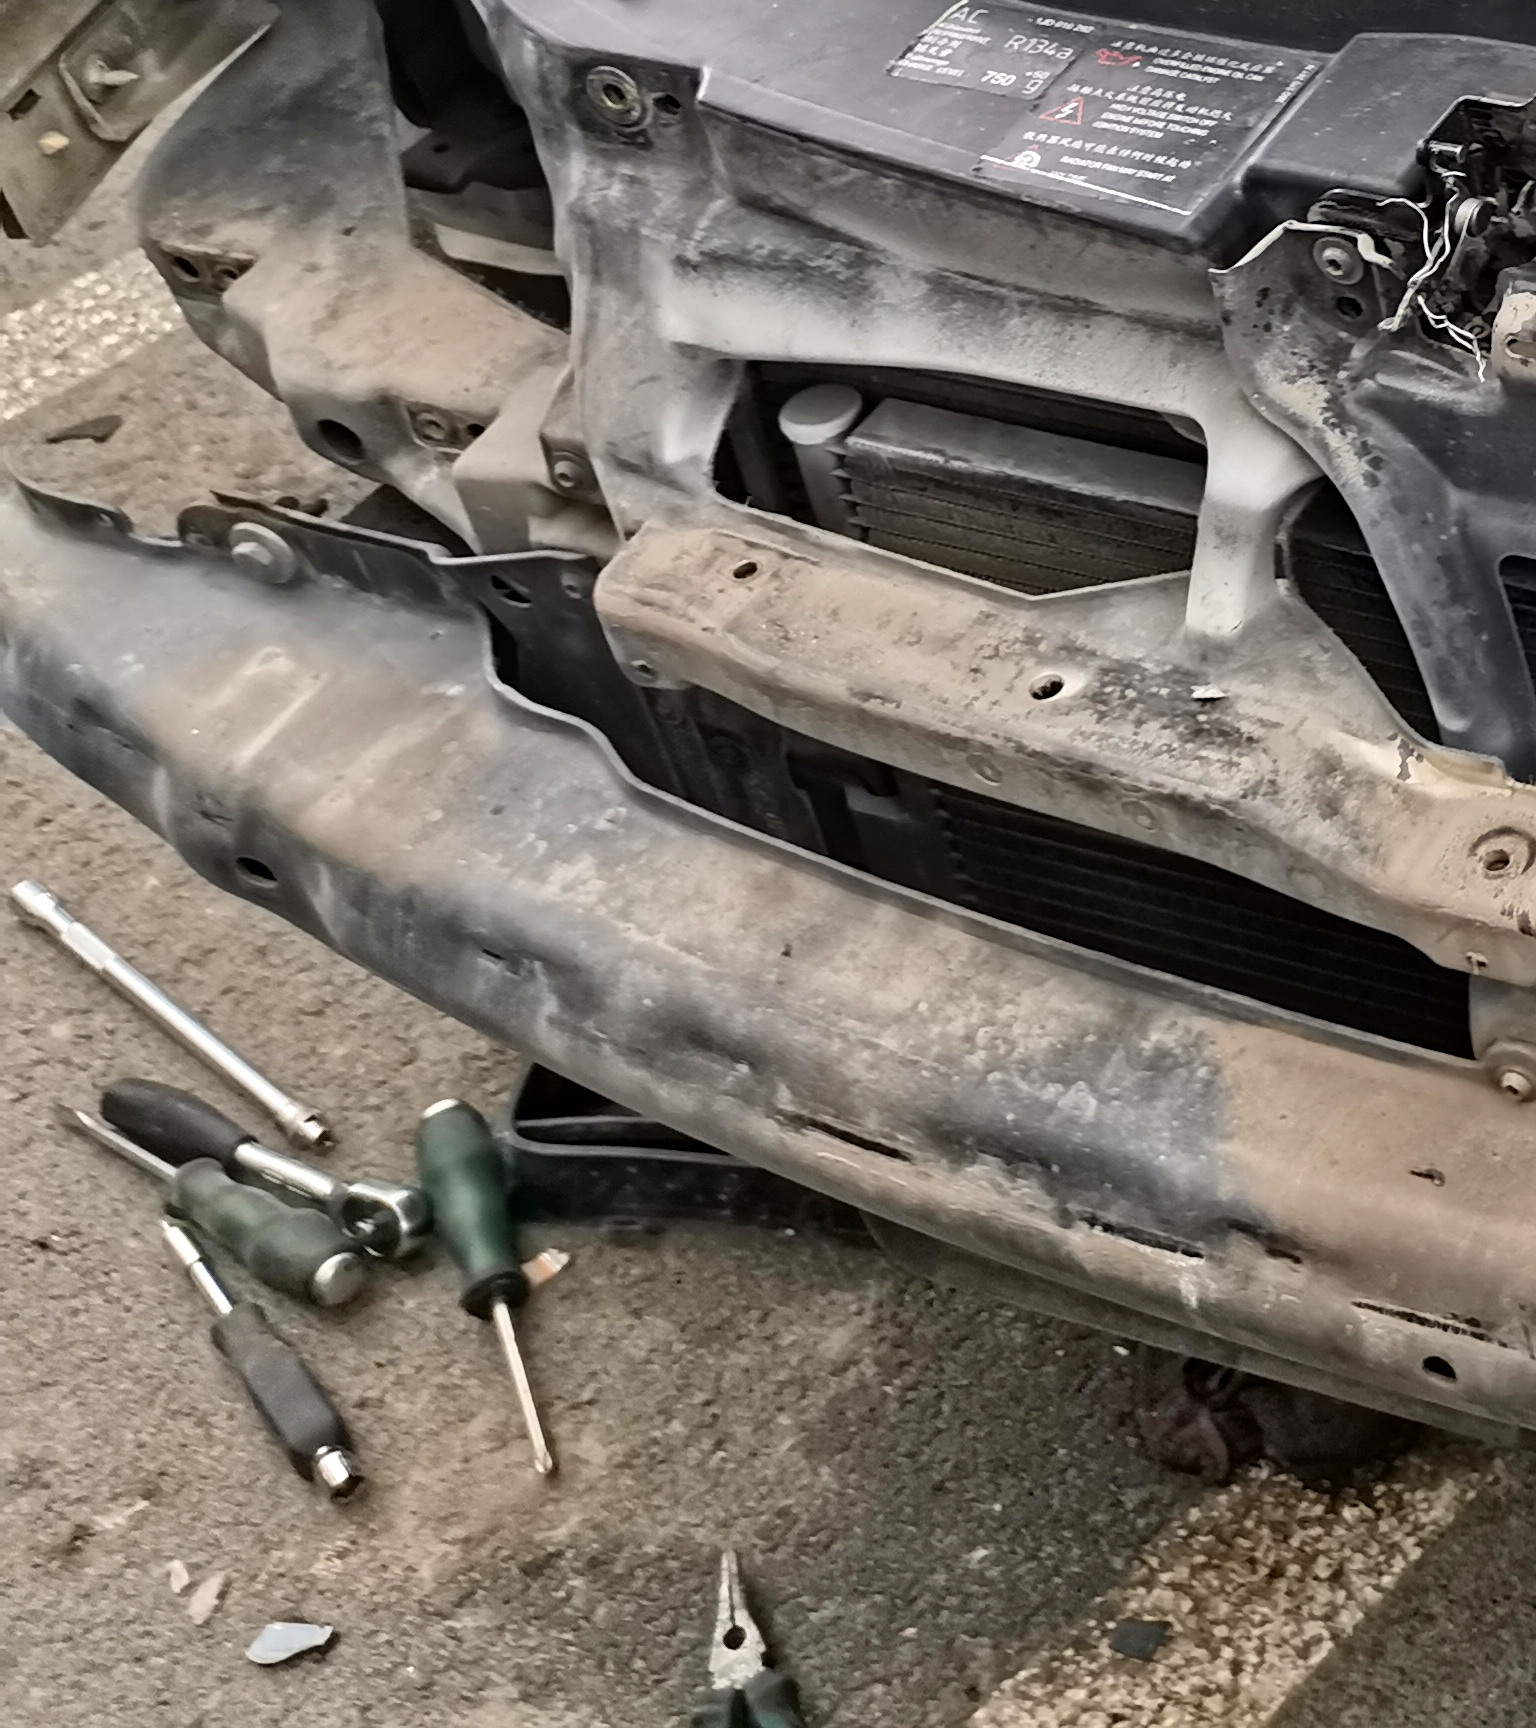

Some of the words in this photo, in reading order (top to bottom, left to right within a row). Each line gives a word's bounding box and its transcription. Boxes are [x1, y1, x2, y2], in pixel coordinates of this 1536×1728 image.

[948, 7, 989, 25] AC
[1003, 34, 1074, 60] R134a
[981, 70, 1017, 86] 750
[1022, 79, 1044, 94] g
